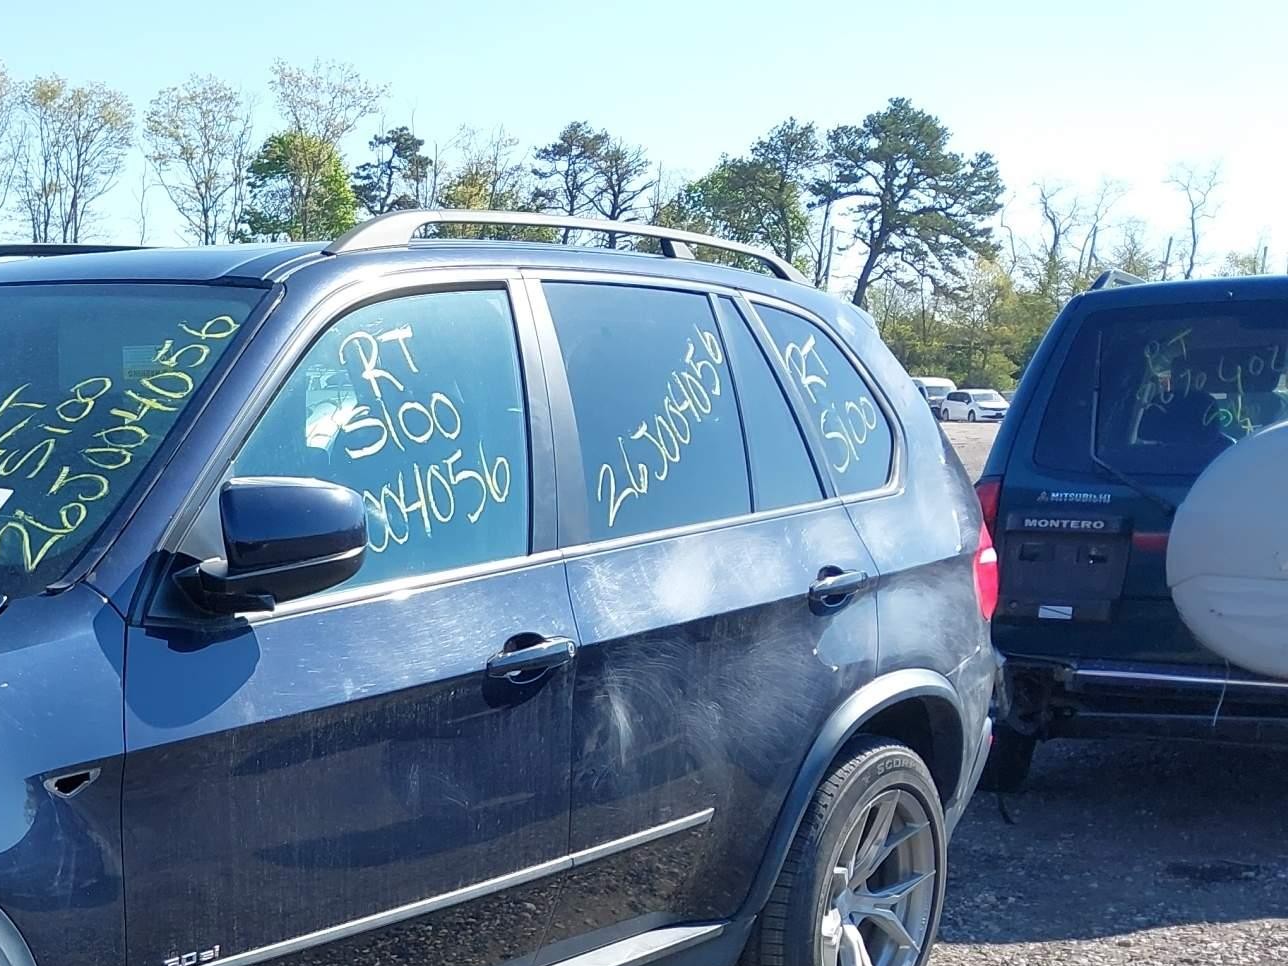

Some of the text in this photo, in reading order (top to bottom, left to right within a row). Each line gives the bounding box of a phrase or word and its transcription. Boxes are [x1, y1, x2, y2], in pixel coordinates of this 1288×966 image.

[339, 324, 419, 400] RT
[785, 334, 829, 404] RT
[1050, 491, 1112, 504] MITSUBISHI
[1023, 518, 1106, 529] MONTERO
